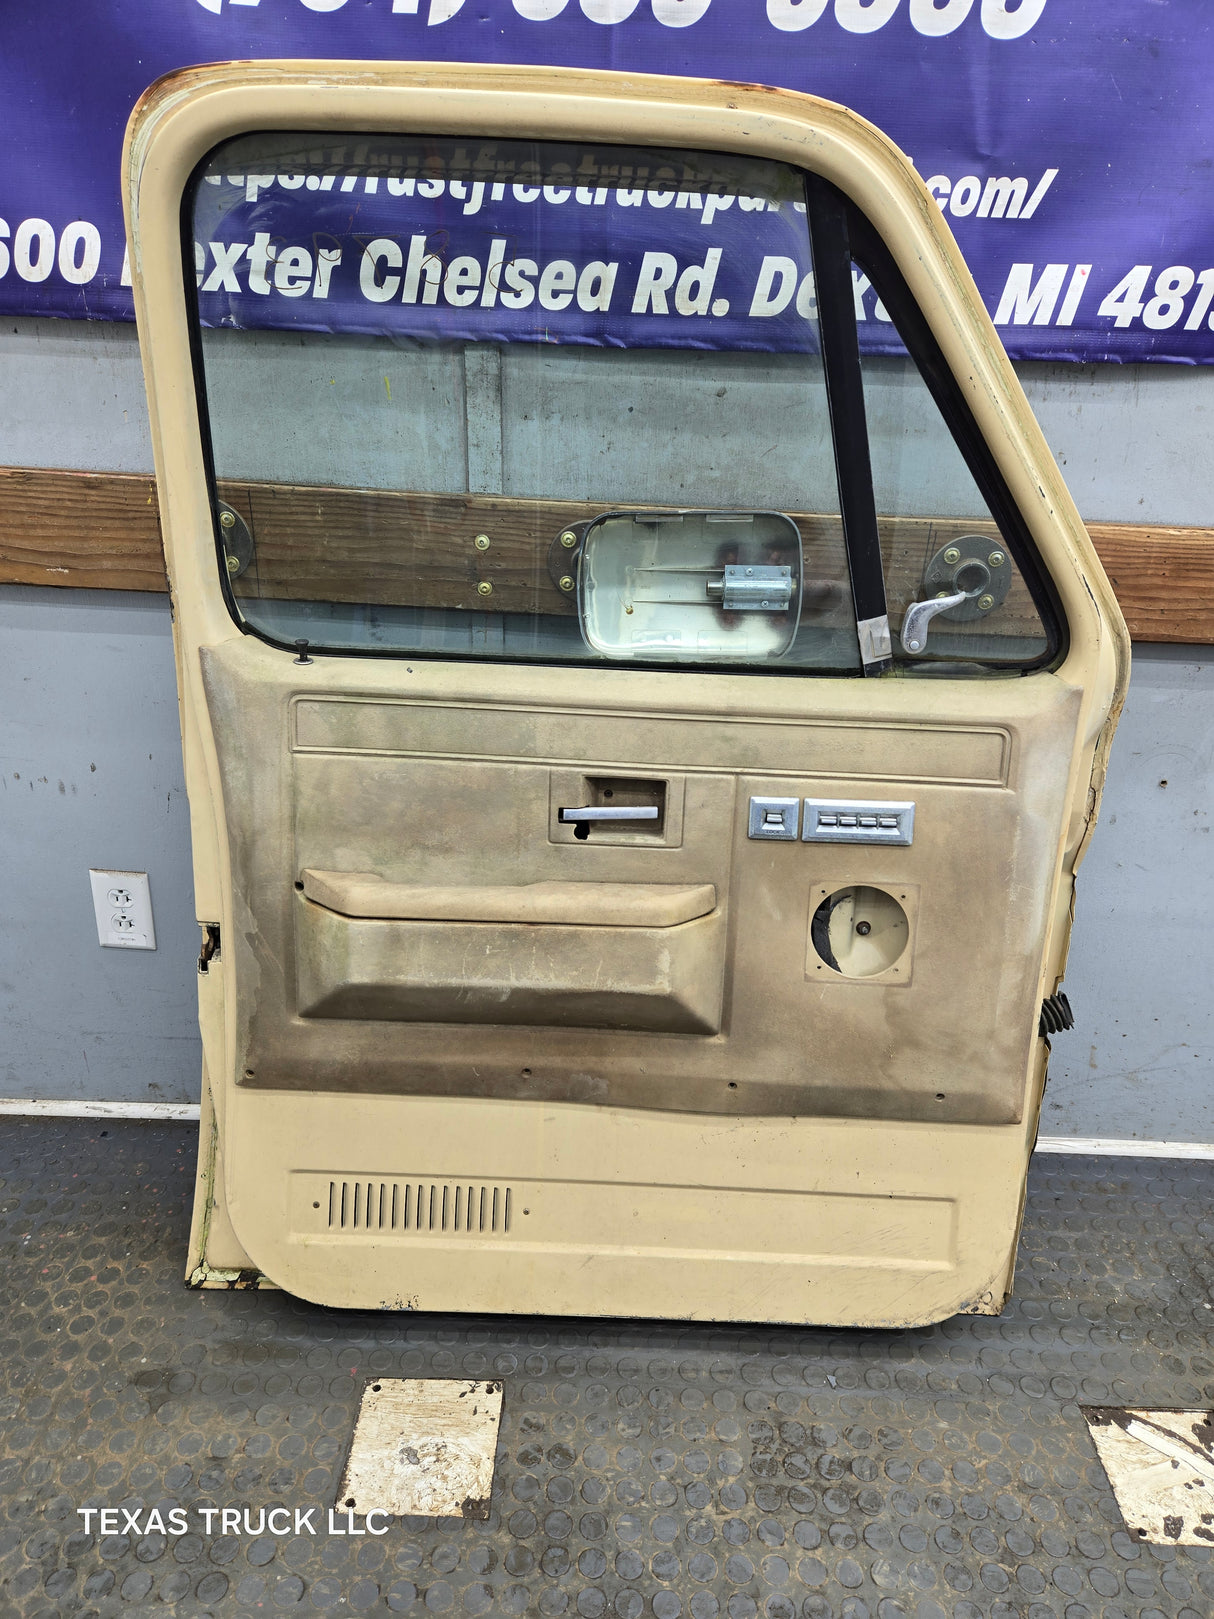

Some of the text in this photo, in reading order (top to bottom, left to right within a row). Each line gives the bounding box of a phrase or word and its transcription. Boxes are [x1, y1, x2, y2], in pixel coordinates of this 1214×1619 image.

[0, 217, 102, 285] 00
[359, 234, 619, 312] Chelsea
[631, 248, 730, 317] Rd.
[993, 263, 1093, 326] MI
[1098, 265, 1214, 332] 481
